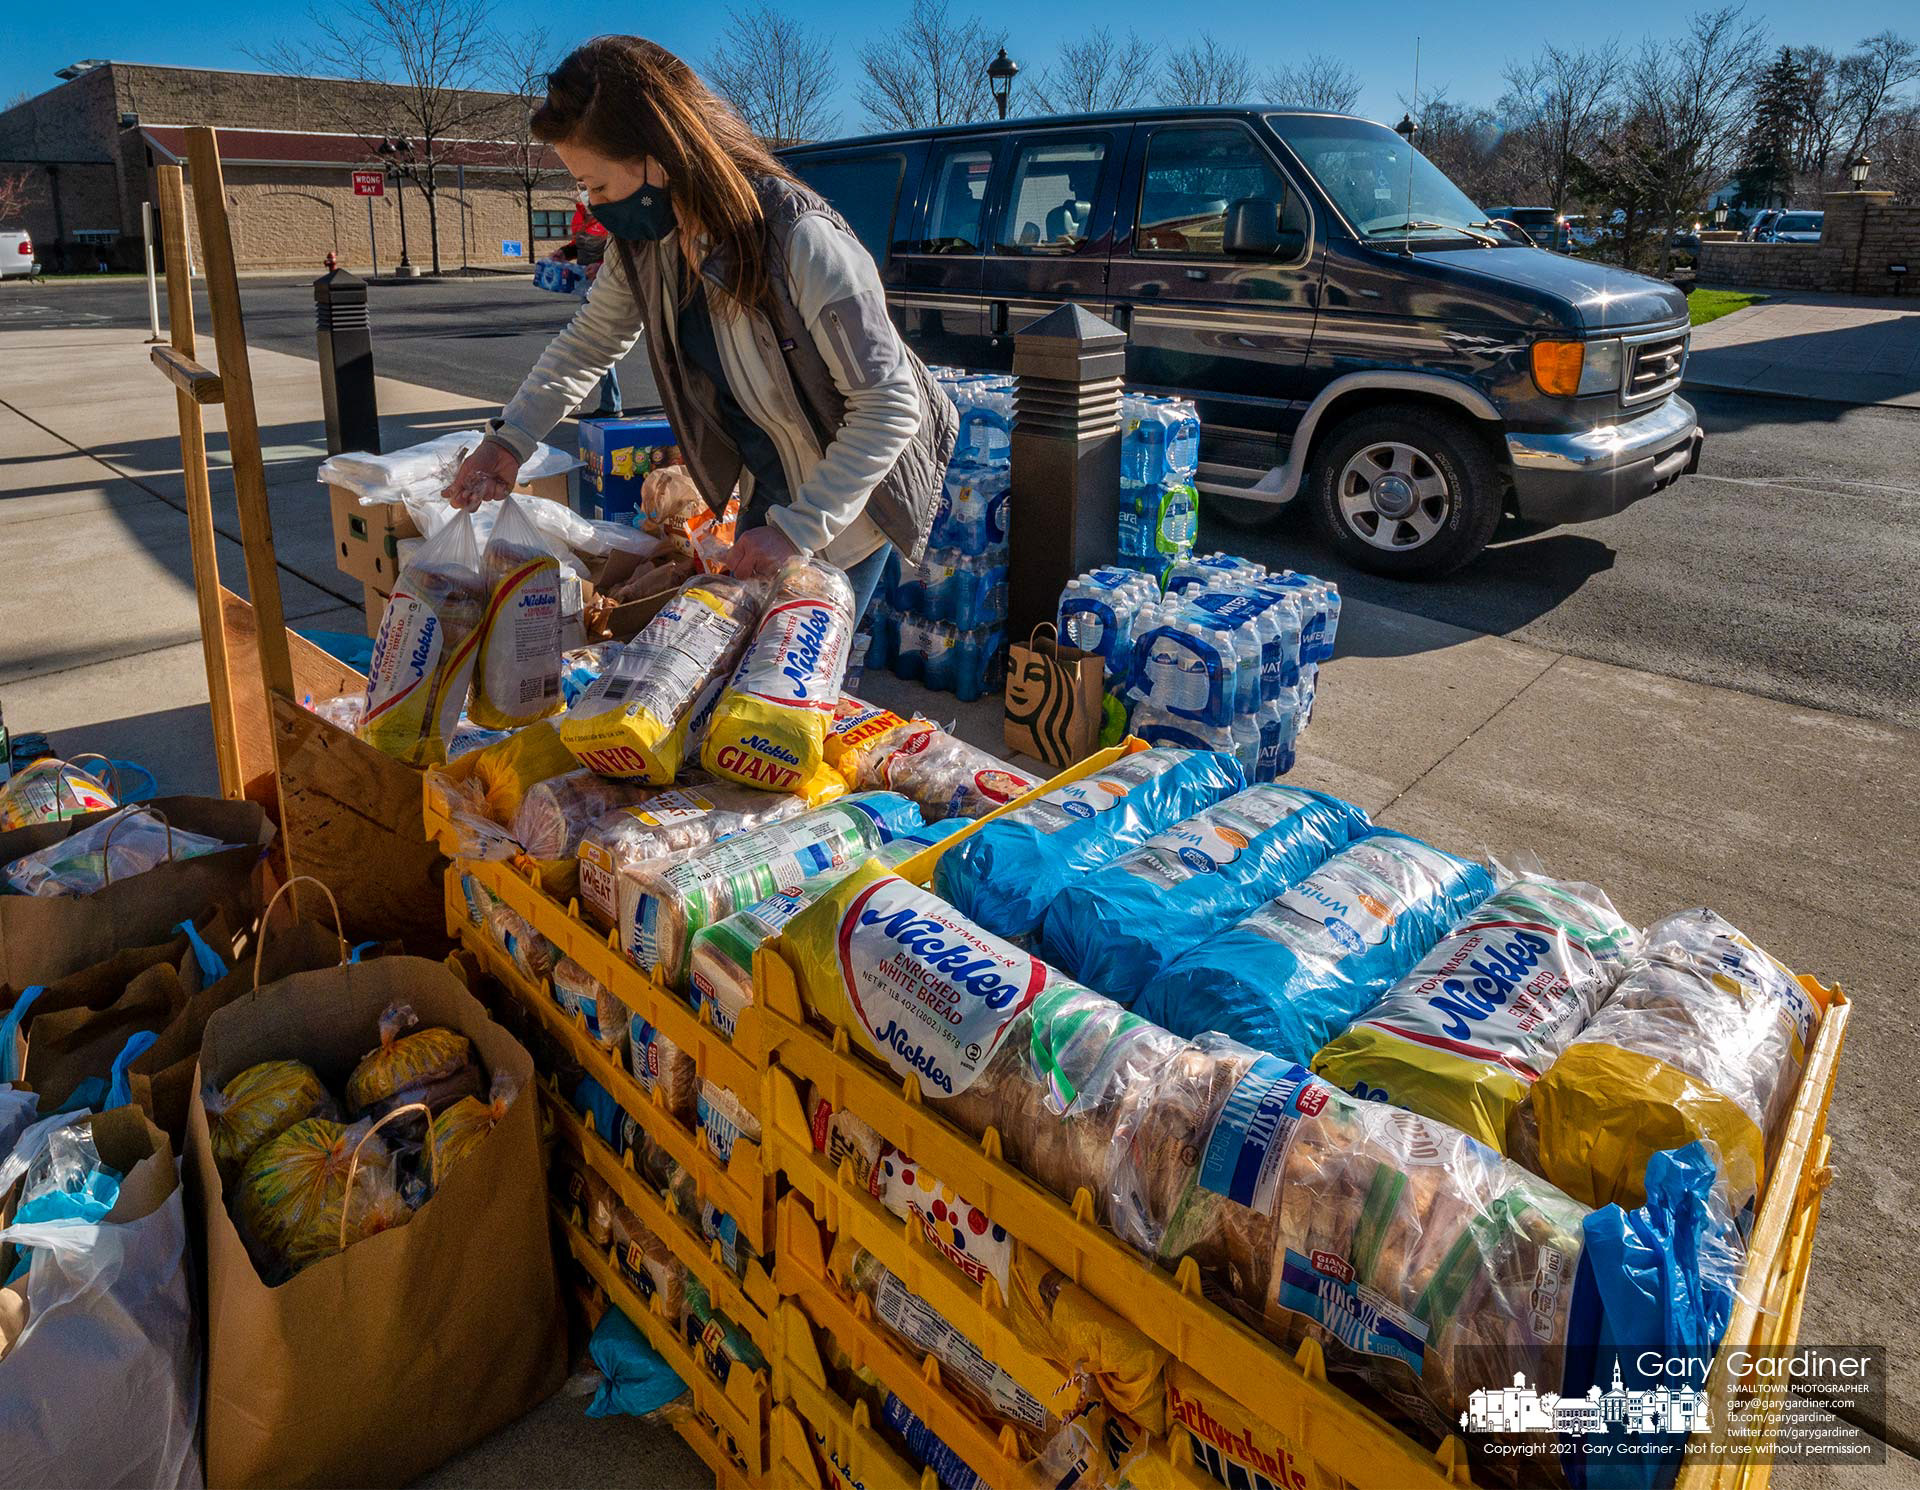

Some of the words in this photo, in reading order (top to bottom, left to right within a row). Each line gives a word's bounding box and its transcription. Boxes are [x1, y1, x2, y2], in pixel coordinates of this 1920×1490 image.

[355, 175, 380, 184] WRONG
[361, 185, 376, 193] WAY
[518, 594, 556, 608] Nickles
[1215, 596, 1249, 618] WATER
[392, 619, 405, 650] BREAD
[410, 616, 437, 678] Nickles
[774, 615, 798, 665] TOASTMASTER
[783, 608, 830, 699] Nickles
[835, 709, 882, 735] Sunbeam
[840, 713, 903, 747] GIANT
[577, 745, 647, 774] GIANT
[717, 745, 802, 788] GIANT
[740, 735, 799, 766] Nickles
[1183, 851, 1210, 873] Great
[1189, 849, 1208, 864] Value
[582, 868, 612, 902] WEAT
[697, 872, 712, 882] 130
[923, 911, 1017, 969] TOASTMASTER
[860, 908, 1020, 1011] Nickles
[894, 952, 961, 1004] ENRICHED
[879, 959, 914, 992] WHITE
[917, 990, 963, 1025] BREAD
[1428, 931, 1551, 1041] Nickles
[1508, 970, 1555, 1019] ENRICHED
[862, 970, 877, 984] NET
[941, 1029, 961, 1049] 567g
[875, 1019, 954, 1095] Nickles
[1263, 1077, 1299, 1116] KING
[1205, 1125, 1232, 1173] BREAD
[1246, 1113, 1279, 1151] SIZE
[1316, 1254, 1349, 1273] GIANT
[1316, 1262, 1347, 1280] EAGLE
[1548, 1252, 1560, 1271] 130
[1318, 1279, 1355, 1317] KING
[1357, 1301, 1384, 1335] SIZE
[1322, 1297, 1374, 1353] WHITE
[1168, 1385, 1307, 1490] Schwebel's
